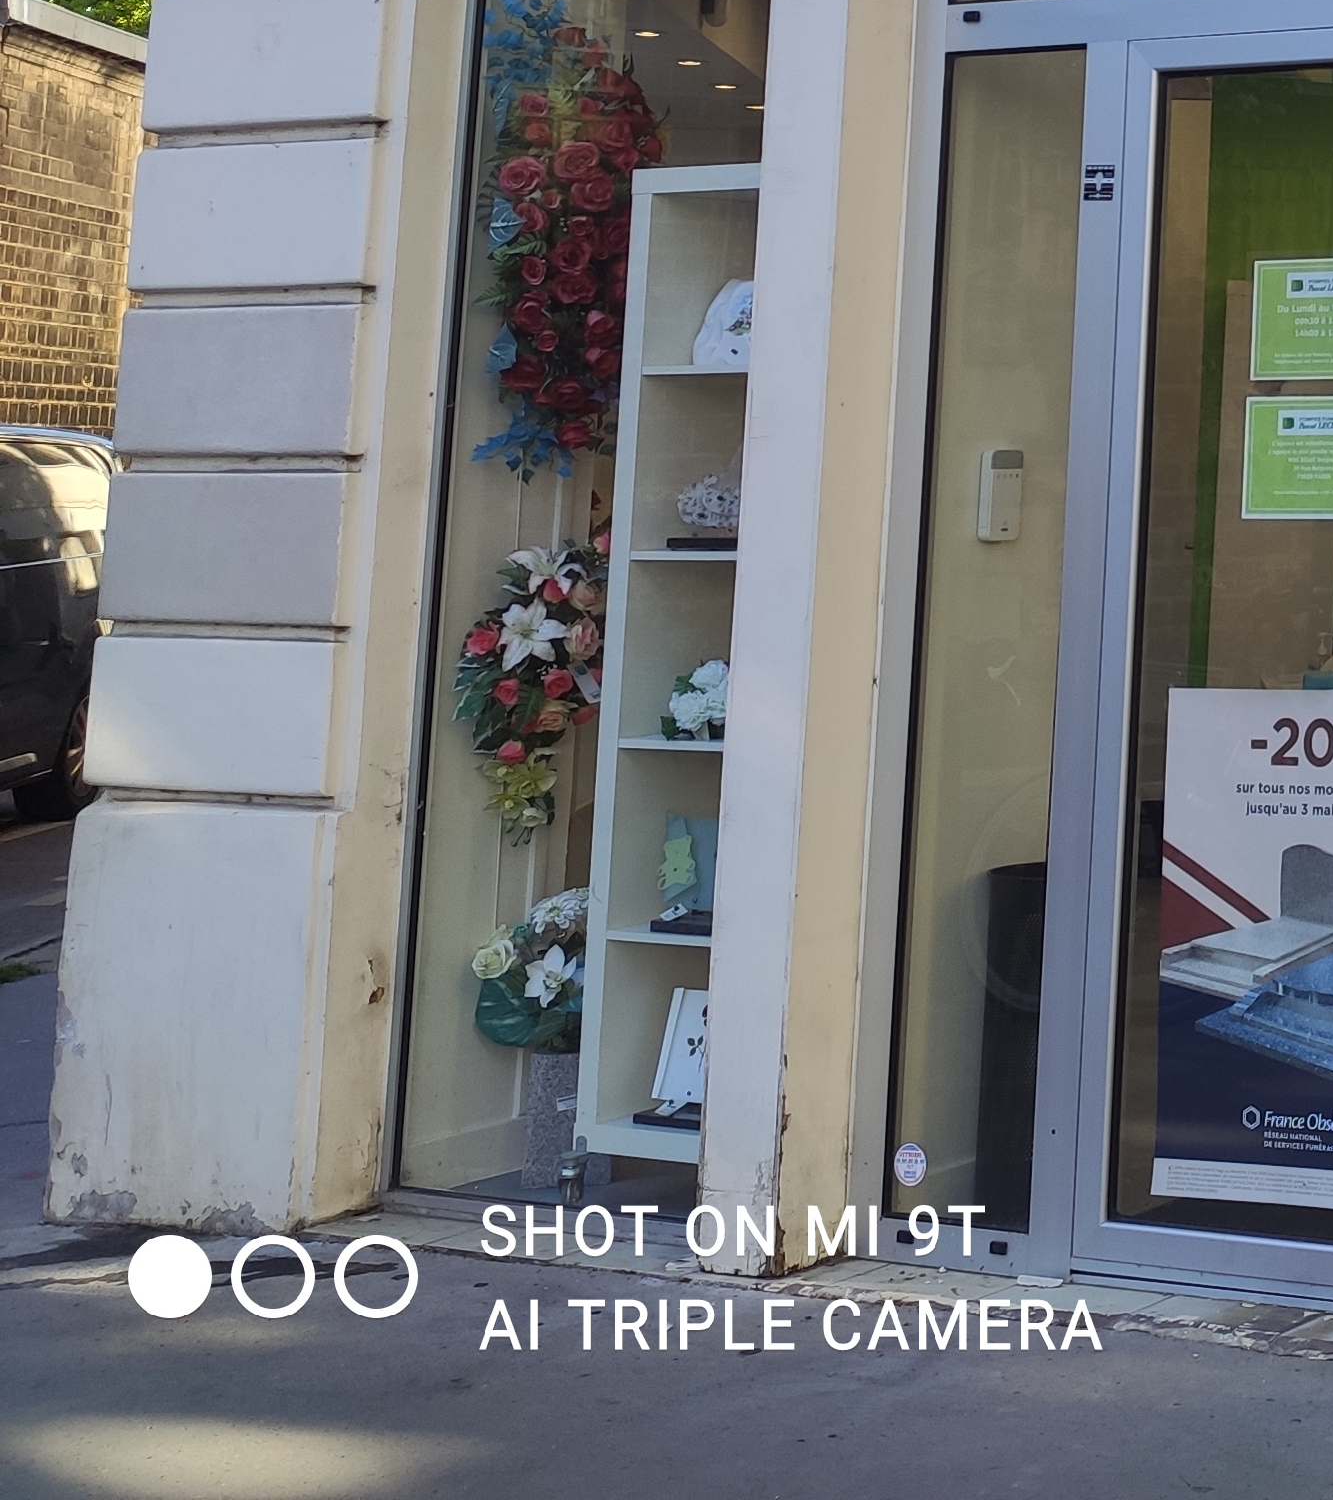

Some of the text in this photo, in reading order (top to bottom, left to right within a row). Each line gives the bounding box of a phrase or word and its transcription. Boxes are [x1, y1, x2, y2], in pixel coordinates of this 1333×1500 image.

[1276, 304, 1289, 313] Du
[1291, 303, 1316, 313] Lundi
[1318, 304, 1330, 312] au
[1236, 782, 1255, 795] sur
[1258, 782, 1285, 795] tous
[1288, 784, 1311, 796] nos
[1245, 801, 1297, 817] jusqu'au
[1300, 803, 1309, 816] 3
[1264, 1110, 1305, 1130] France
[1289, 1132, 1323, 1142] NATIONAL
[1263, 1140, 1273, 1148] DE
[1273, 1141, 1304, 1151] SERVICES
